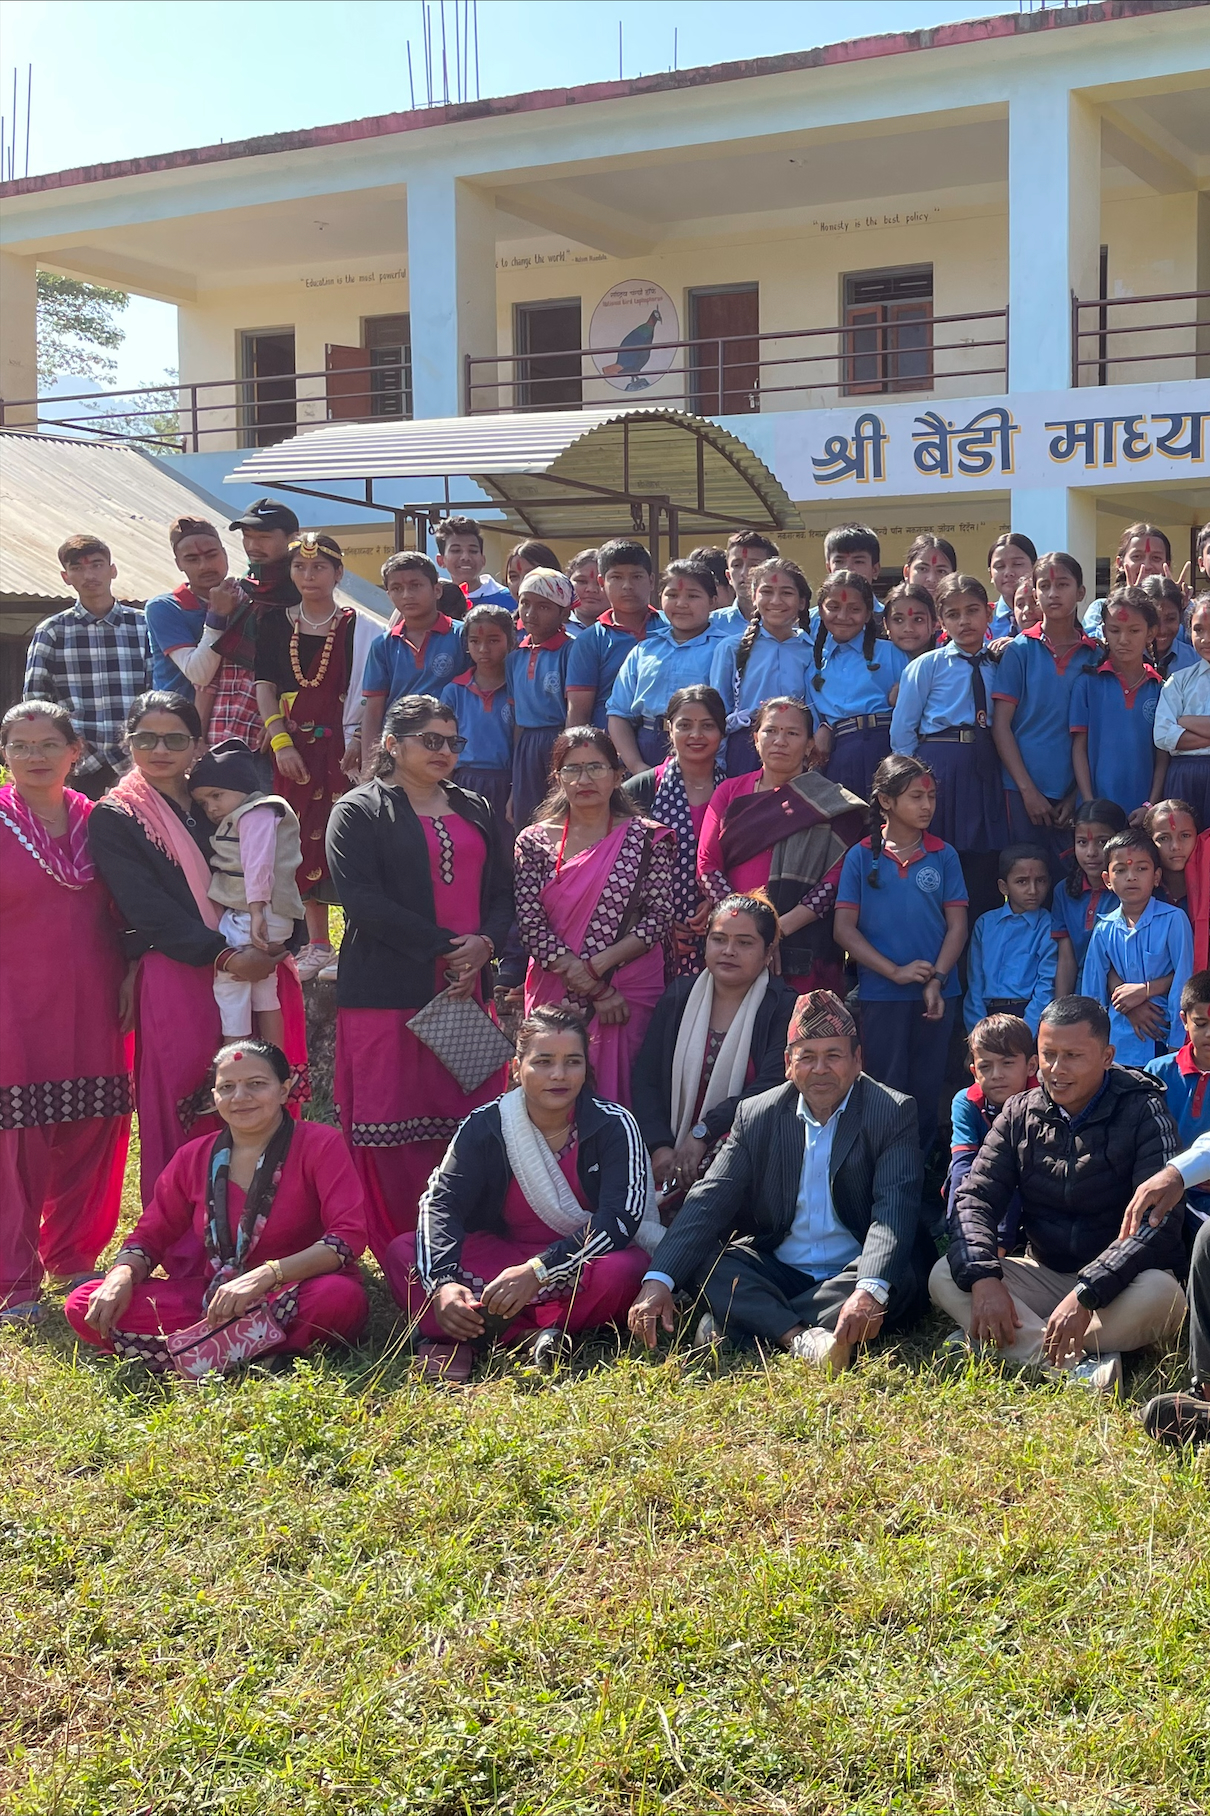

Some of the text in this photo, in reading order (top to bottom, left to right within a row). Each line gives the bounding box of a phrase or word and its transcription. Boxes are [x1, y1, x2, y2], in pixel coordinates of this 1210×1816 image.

[855, 219, 861, 228] is
[866, 216, 877, 226] the
[883, 213, 900, 224] best
[511, 256, 531, 269] change
[534, 254, 545, 264] the
[337, 275, 342, 284] is
[345, 274, 355, 284] the
[359, 272, 376, 282] most
[379, 268, 407, 283] powerful
[811, 413, 891, 484] श्री
[911, 407, 1021, 478] बैंडी
